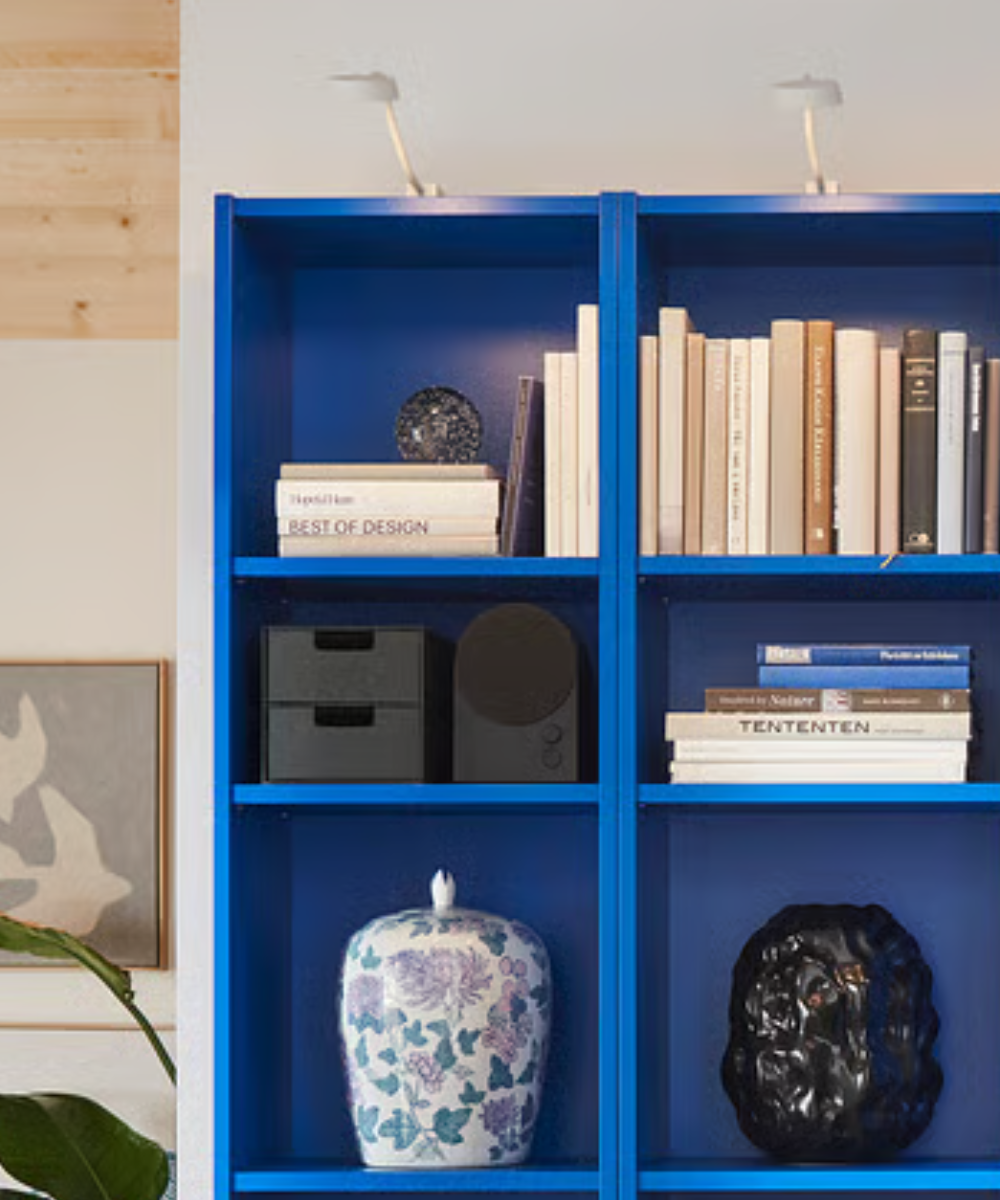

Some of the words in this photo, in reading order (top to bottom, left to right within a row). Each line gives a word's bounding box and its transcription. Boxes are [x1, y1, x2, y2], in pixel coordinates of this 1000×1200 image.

[288, 519, 330, 536] BEST
[334, 519, 358, 536] OF
[363, 519, 428, 536] DESIGN
[739, 719, 871, 734] TENTENTEN
